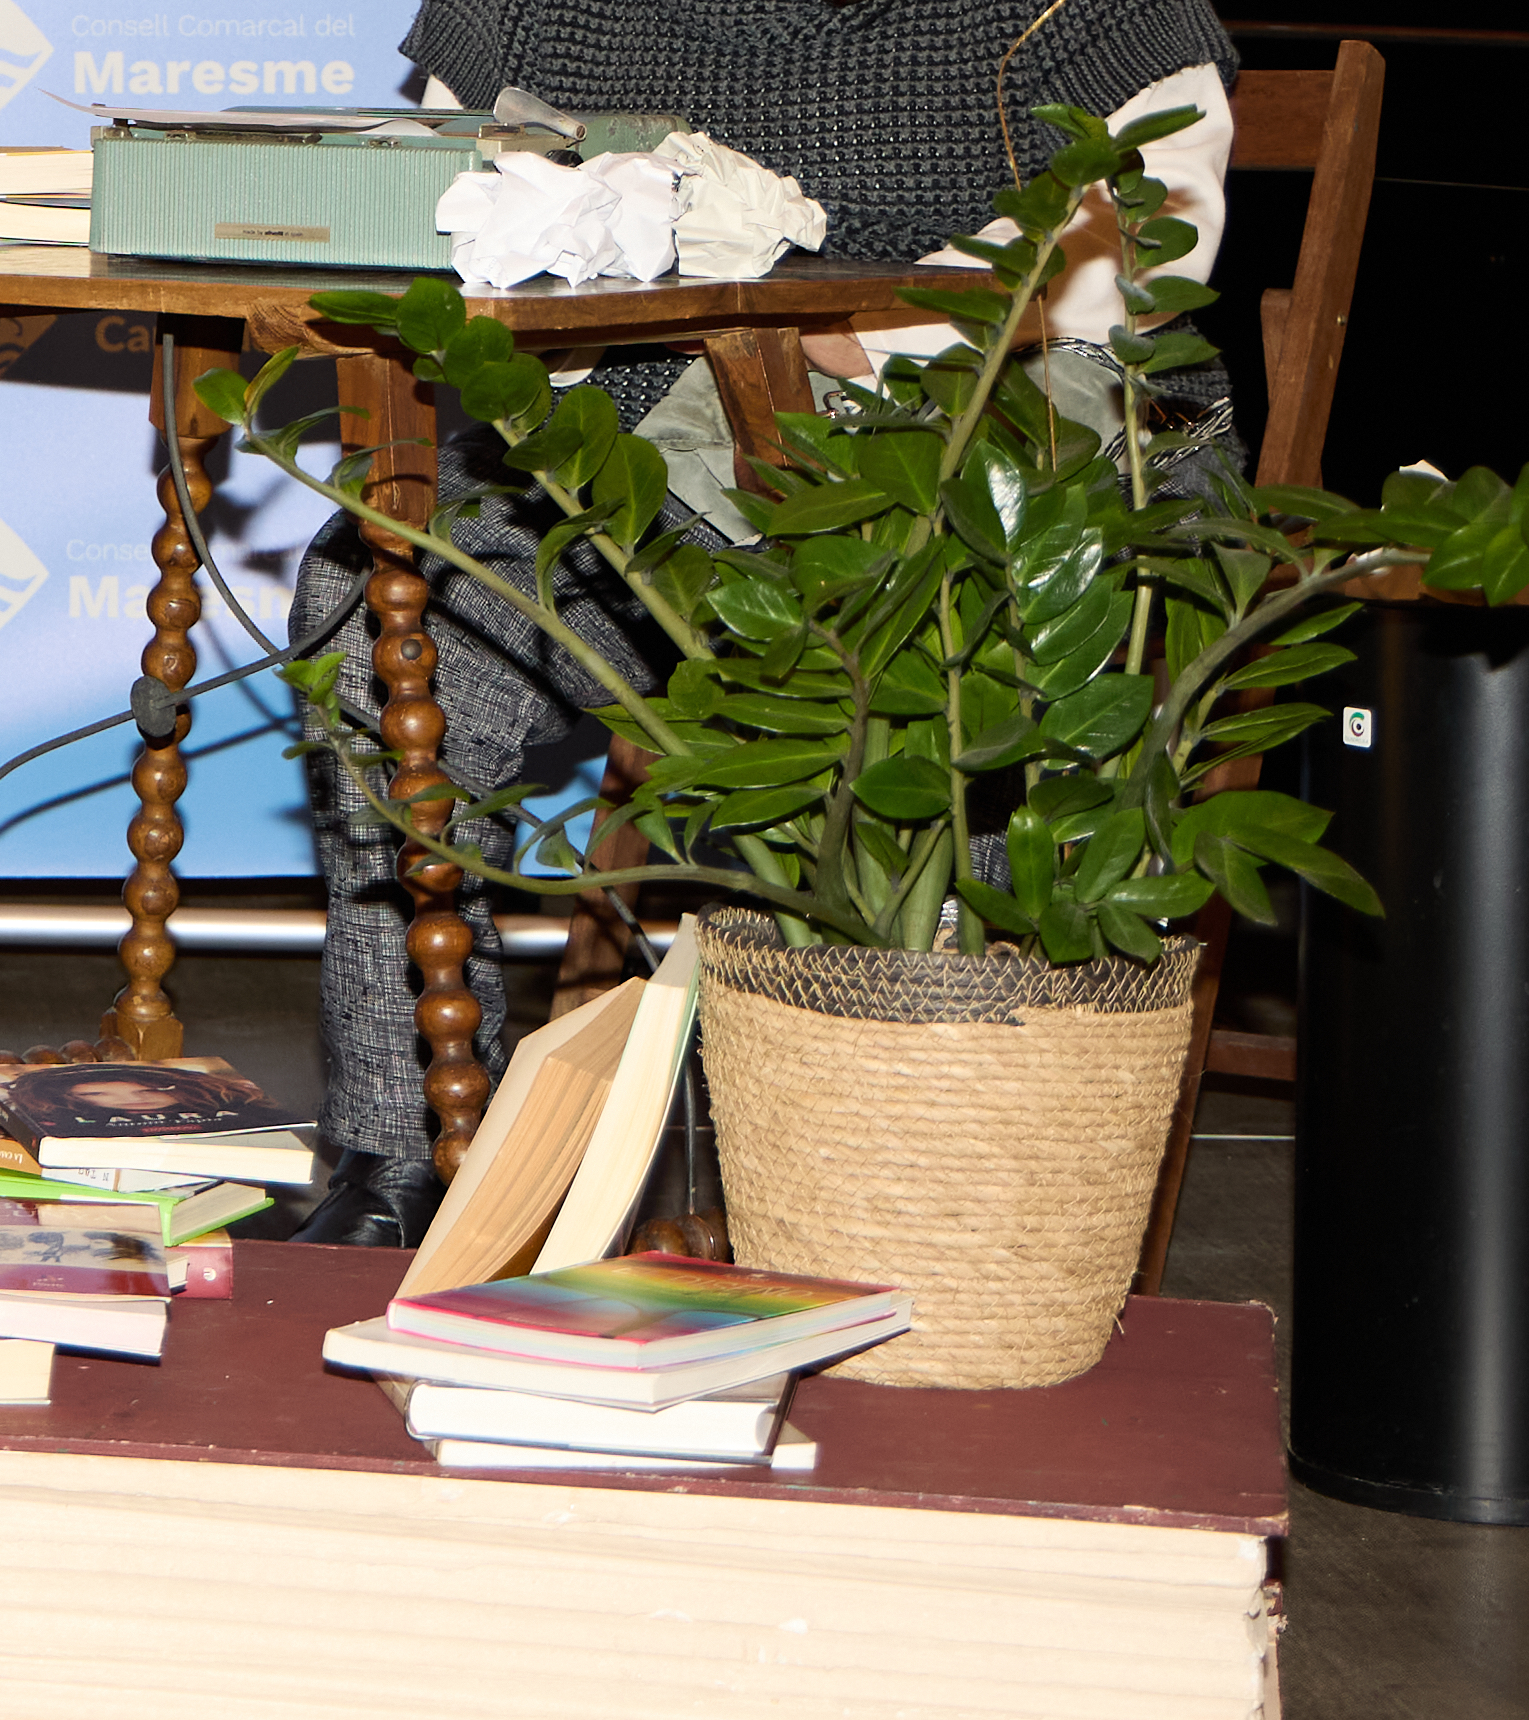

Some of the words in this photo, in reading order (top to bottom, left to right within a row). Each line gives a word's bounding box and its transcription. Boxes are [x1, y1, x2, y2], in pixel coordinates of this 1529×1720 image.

[70, 13, 170, 38] Consell
[177, 13, 307, 38] Comarcal
[314, 13, 356, 38] del
[74, 50, 356, 95] Maresme
[74, 1109, 239, 1124] LAURA
